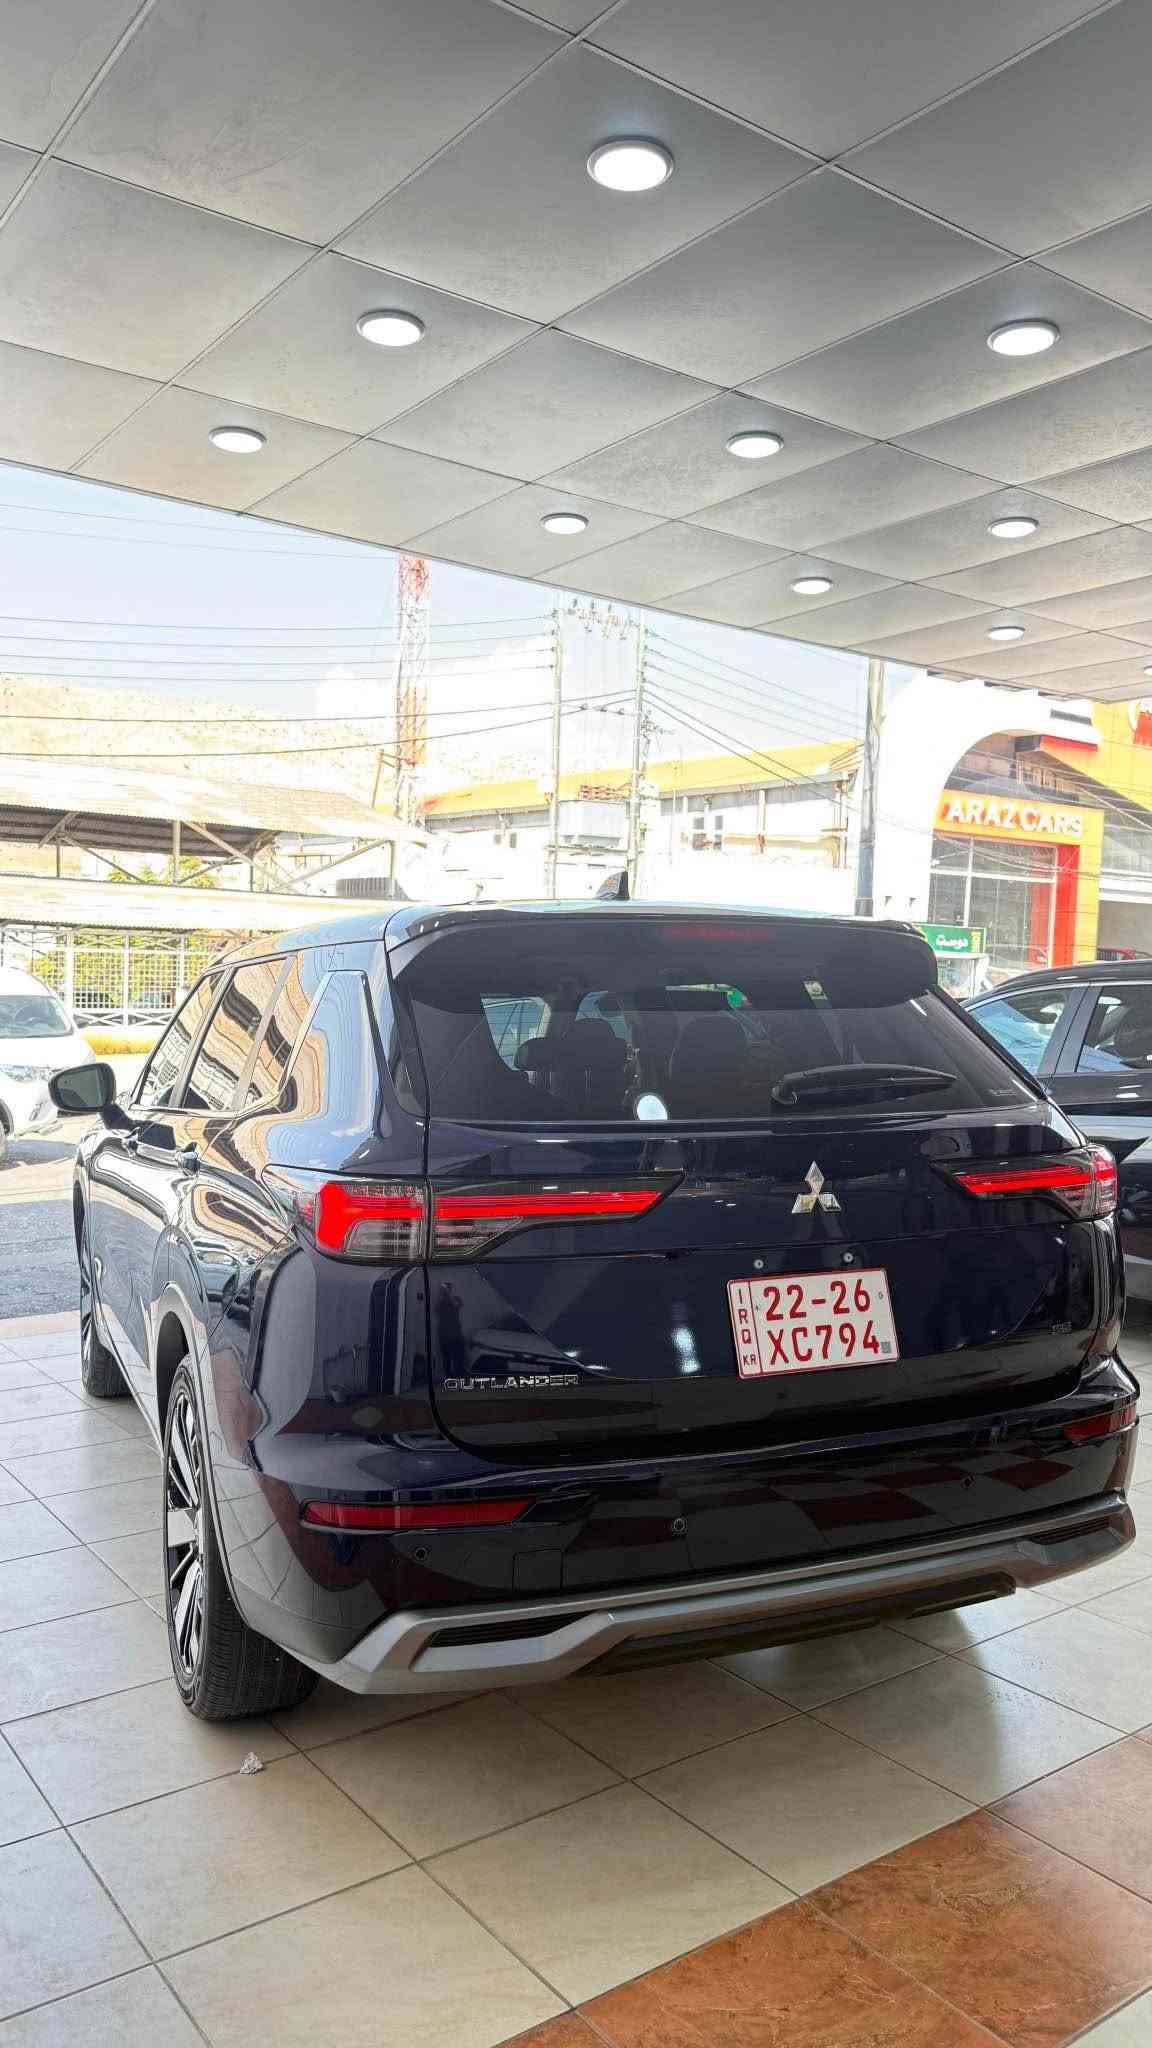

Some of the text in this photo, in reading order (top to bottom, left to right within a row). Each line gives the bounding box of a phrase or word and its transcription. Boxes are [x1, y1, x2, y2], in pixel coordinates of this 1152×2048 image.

[738, 1288, 752, 1345] IRQ
[763, 1279, 871, 1321] 22-26
[742, 1353, 757, 1366] KR
[767, 1320, 880, 1365] XC794
[444, 1374, 578, 1391] OUTLANDER
